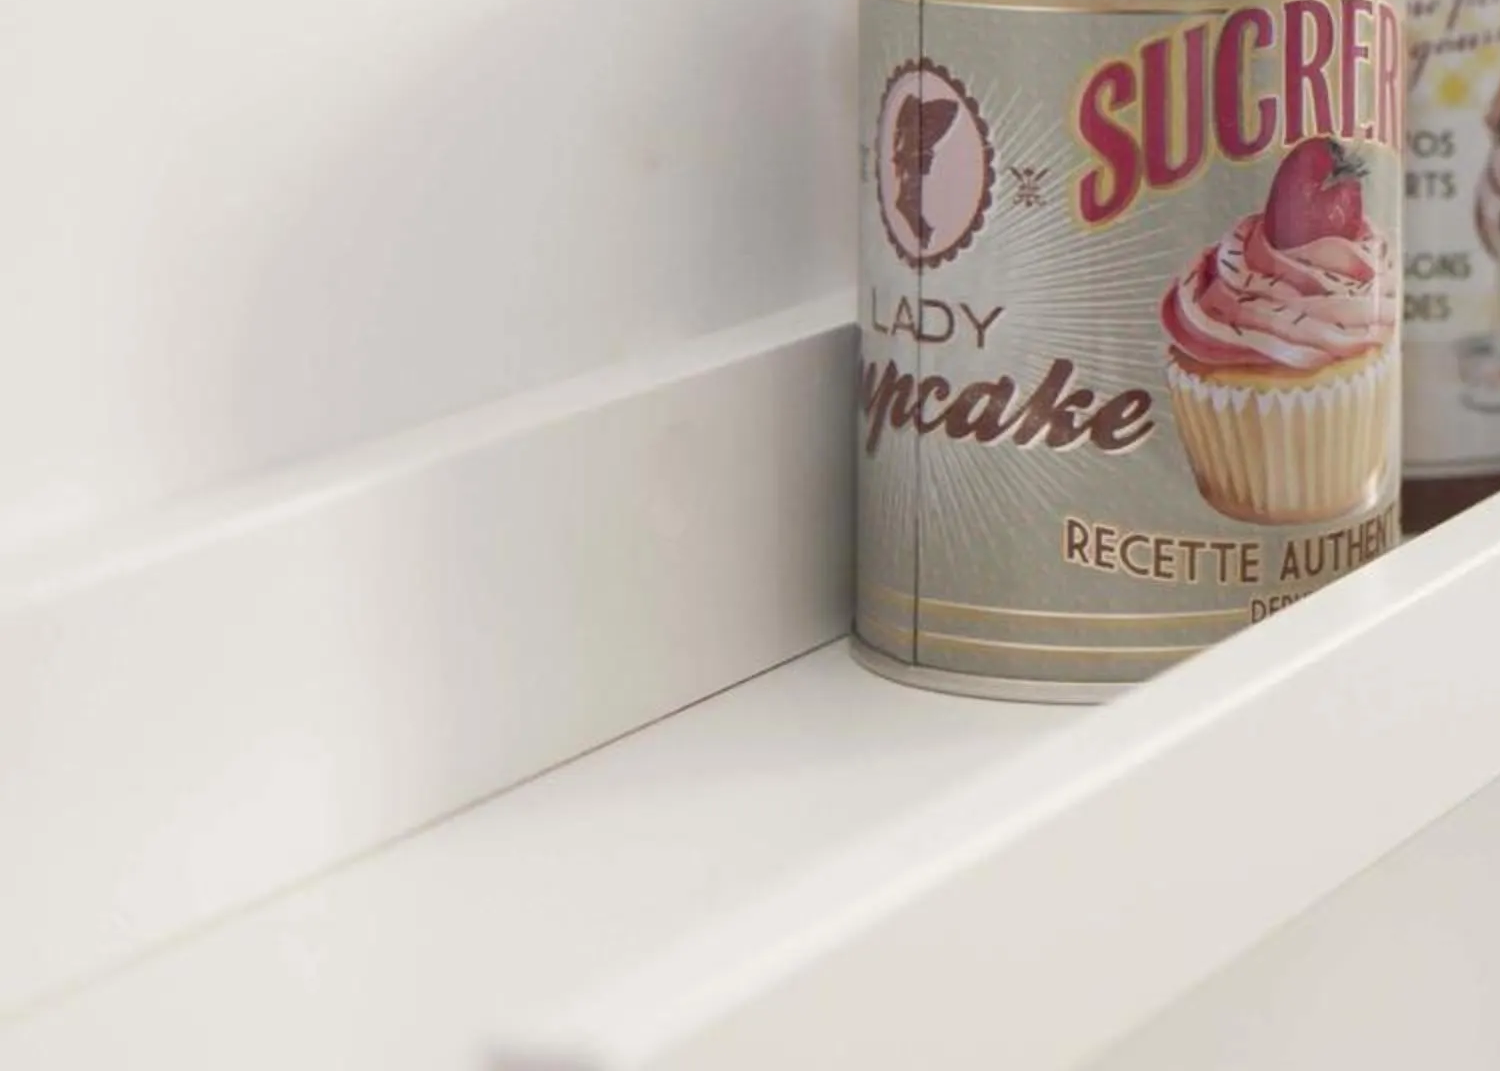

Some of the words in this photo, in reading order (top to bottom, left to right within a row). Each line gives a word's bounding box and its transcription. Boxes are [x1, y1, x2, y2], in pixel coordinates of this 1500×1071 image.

[1406, 130, 1456, 158] OS
[870, 287, 1004, 349] LADY
[1065, 518, 1261, 583] RECETTE
